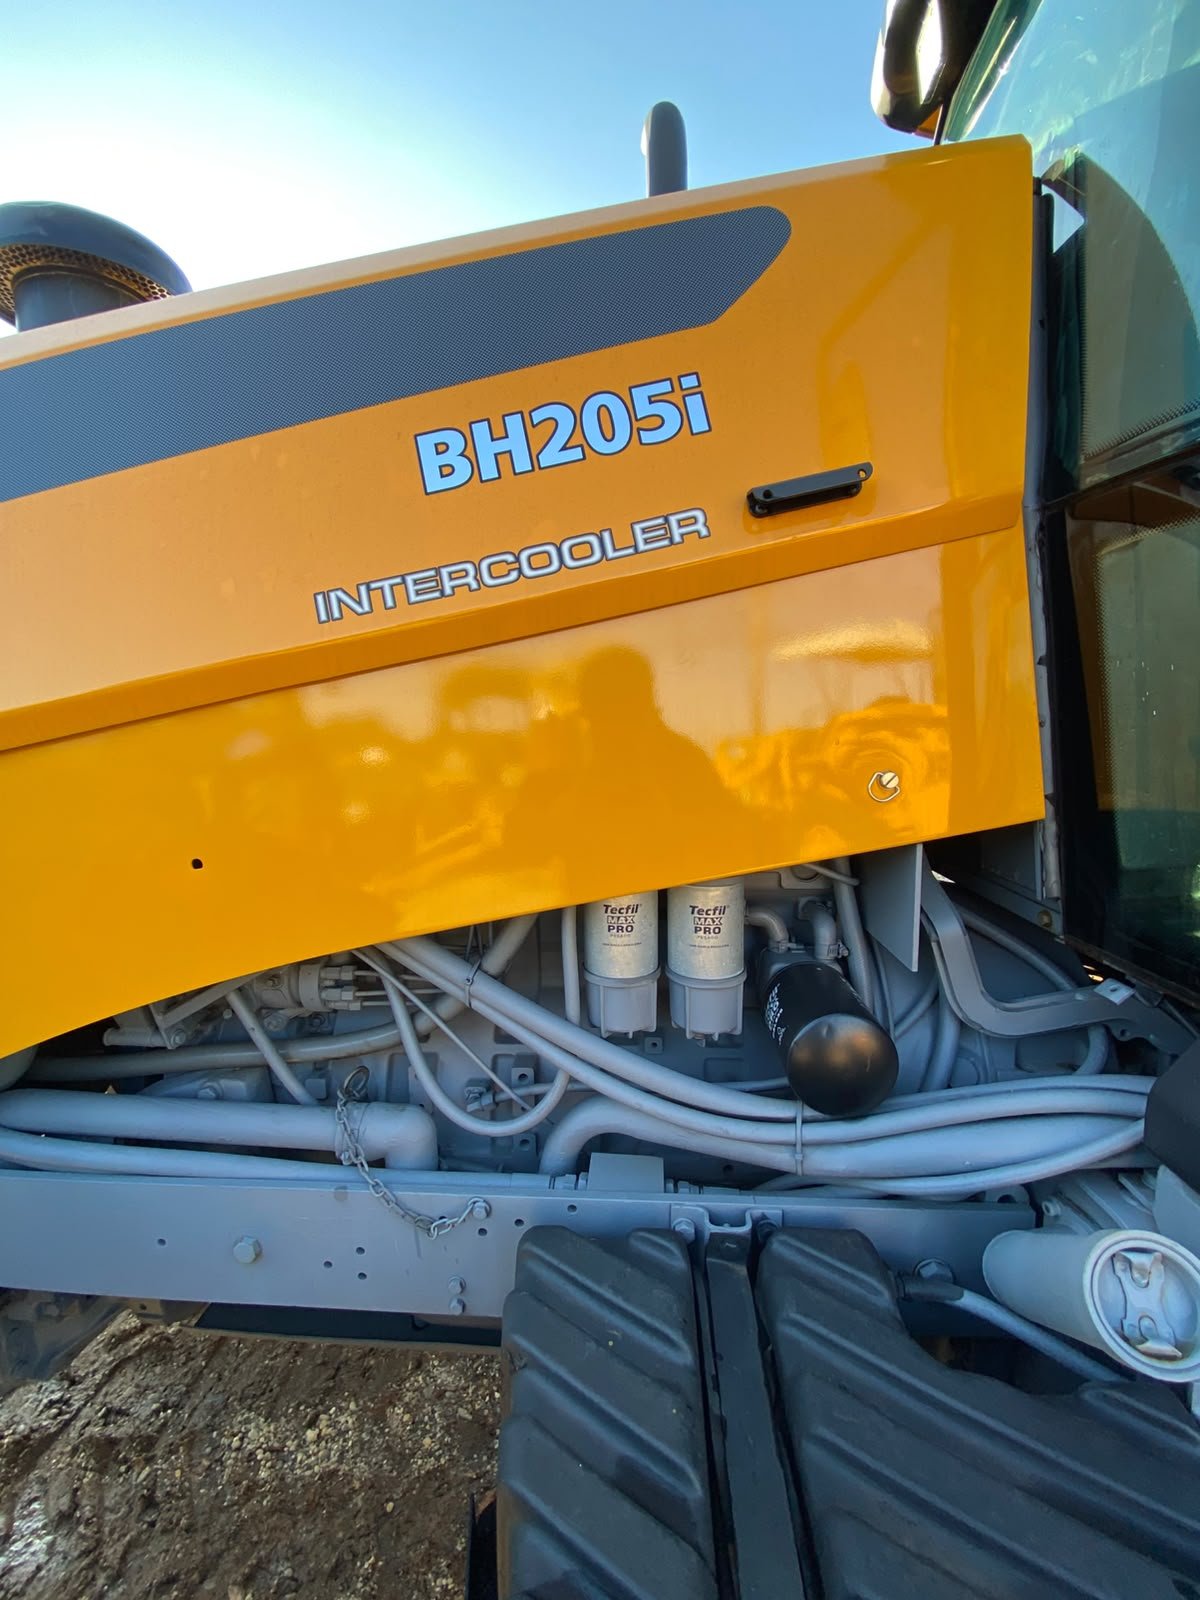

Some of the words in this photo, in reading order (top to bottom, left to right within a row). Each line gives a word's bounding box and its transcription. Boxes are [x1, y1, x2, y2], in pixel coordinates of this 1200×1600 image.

[414, 372, 711, 495] BH205i
[313, 507, 711, 624] INTERCOOLER
[603, 903, 639, 914] Tecfil
[689, 904, 726, 916] Tecfil
[607, 915, 635, 924] MAX
[693, 916, 723, 926] MAX
[607, 924, 634, 933] PRO
[694, 926, 721, 935] PRO
